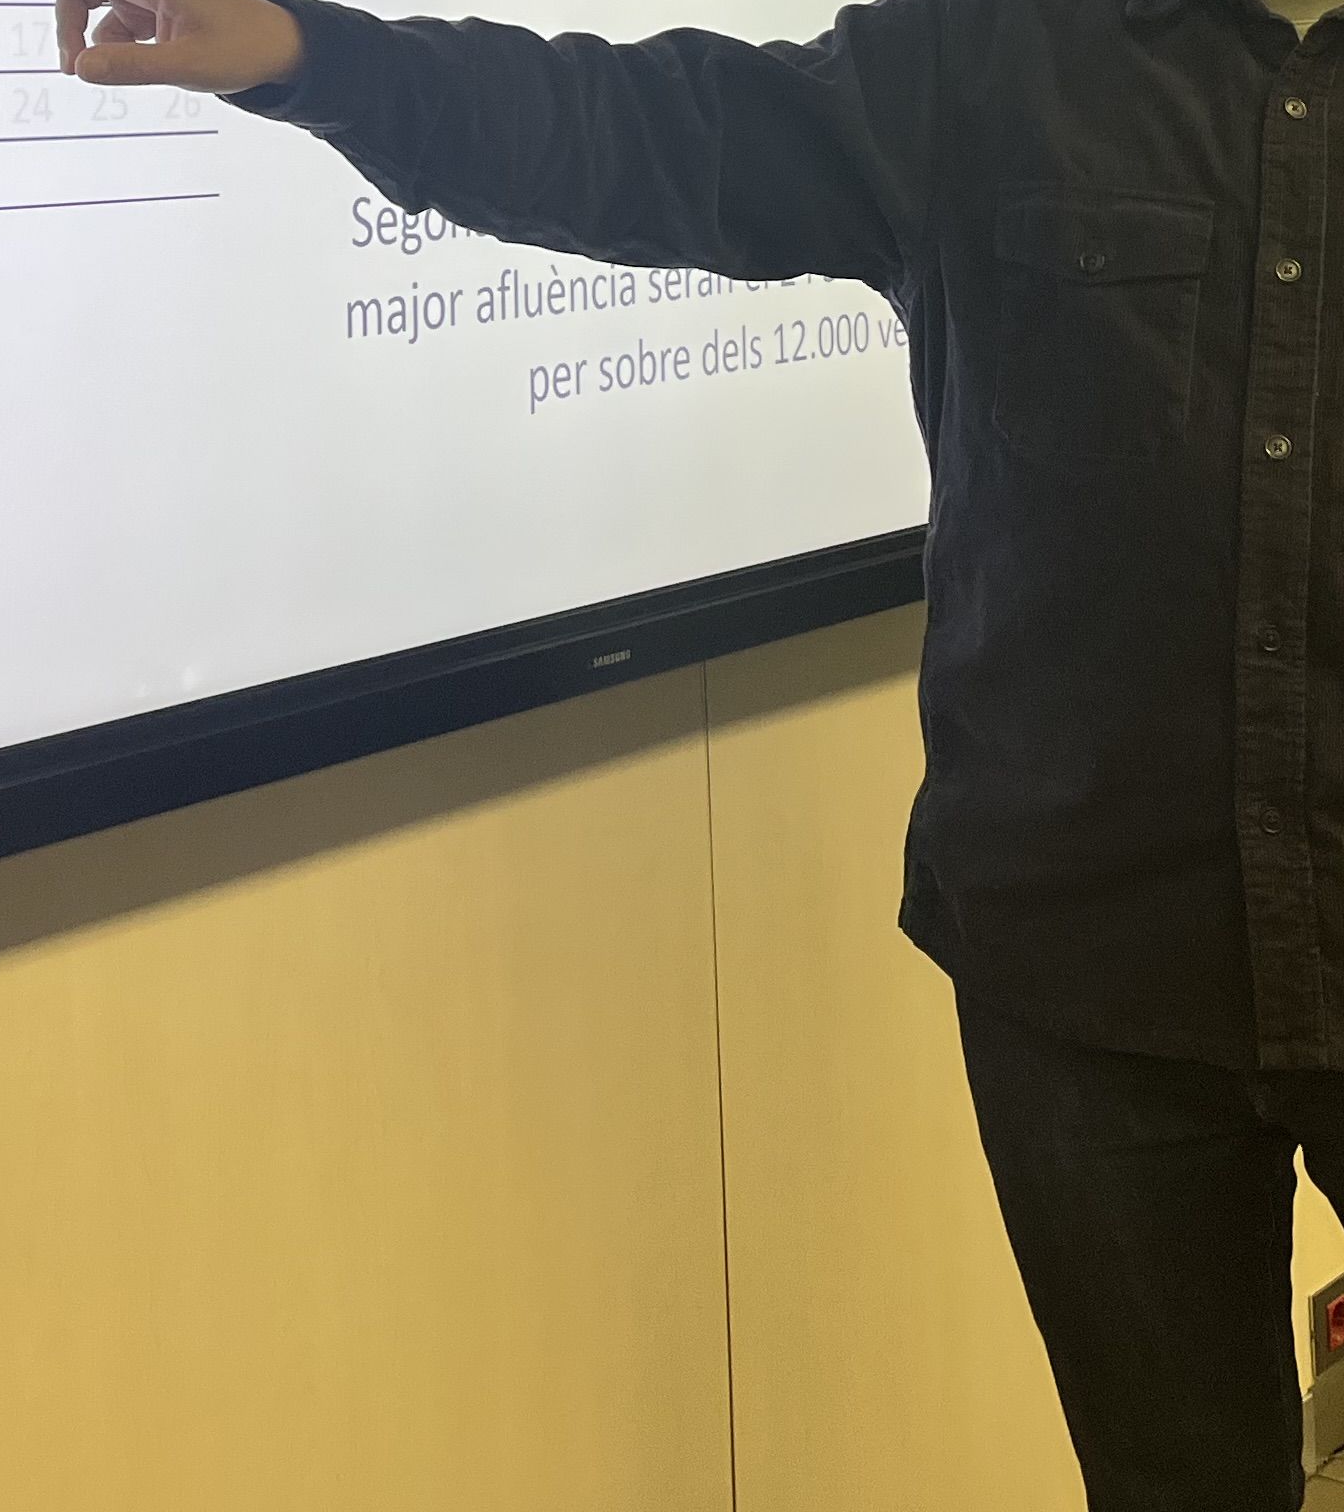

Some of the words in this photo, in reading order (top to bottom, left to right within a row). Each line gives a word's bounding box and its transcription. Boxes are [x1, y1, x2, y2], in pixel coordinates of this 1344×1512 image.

[12, 20, 51, 55] 17
[12, 88, 53, 123] 24
[91, 88, 128, 121] 25
[165, 88, 201, 118] 26
[352, 196, 486, 255] Sego
[346, 278, 463, 344] major
[476, 266, 636, 323] afluència
[530, 360, 587, 414] per
[600, 339, 690, 392] sobre
[703, 325, 762, 376] dels
[775, 312, 868, 364] 12.000
